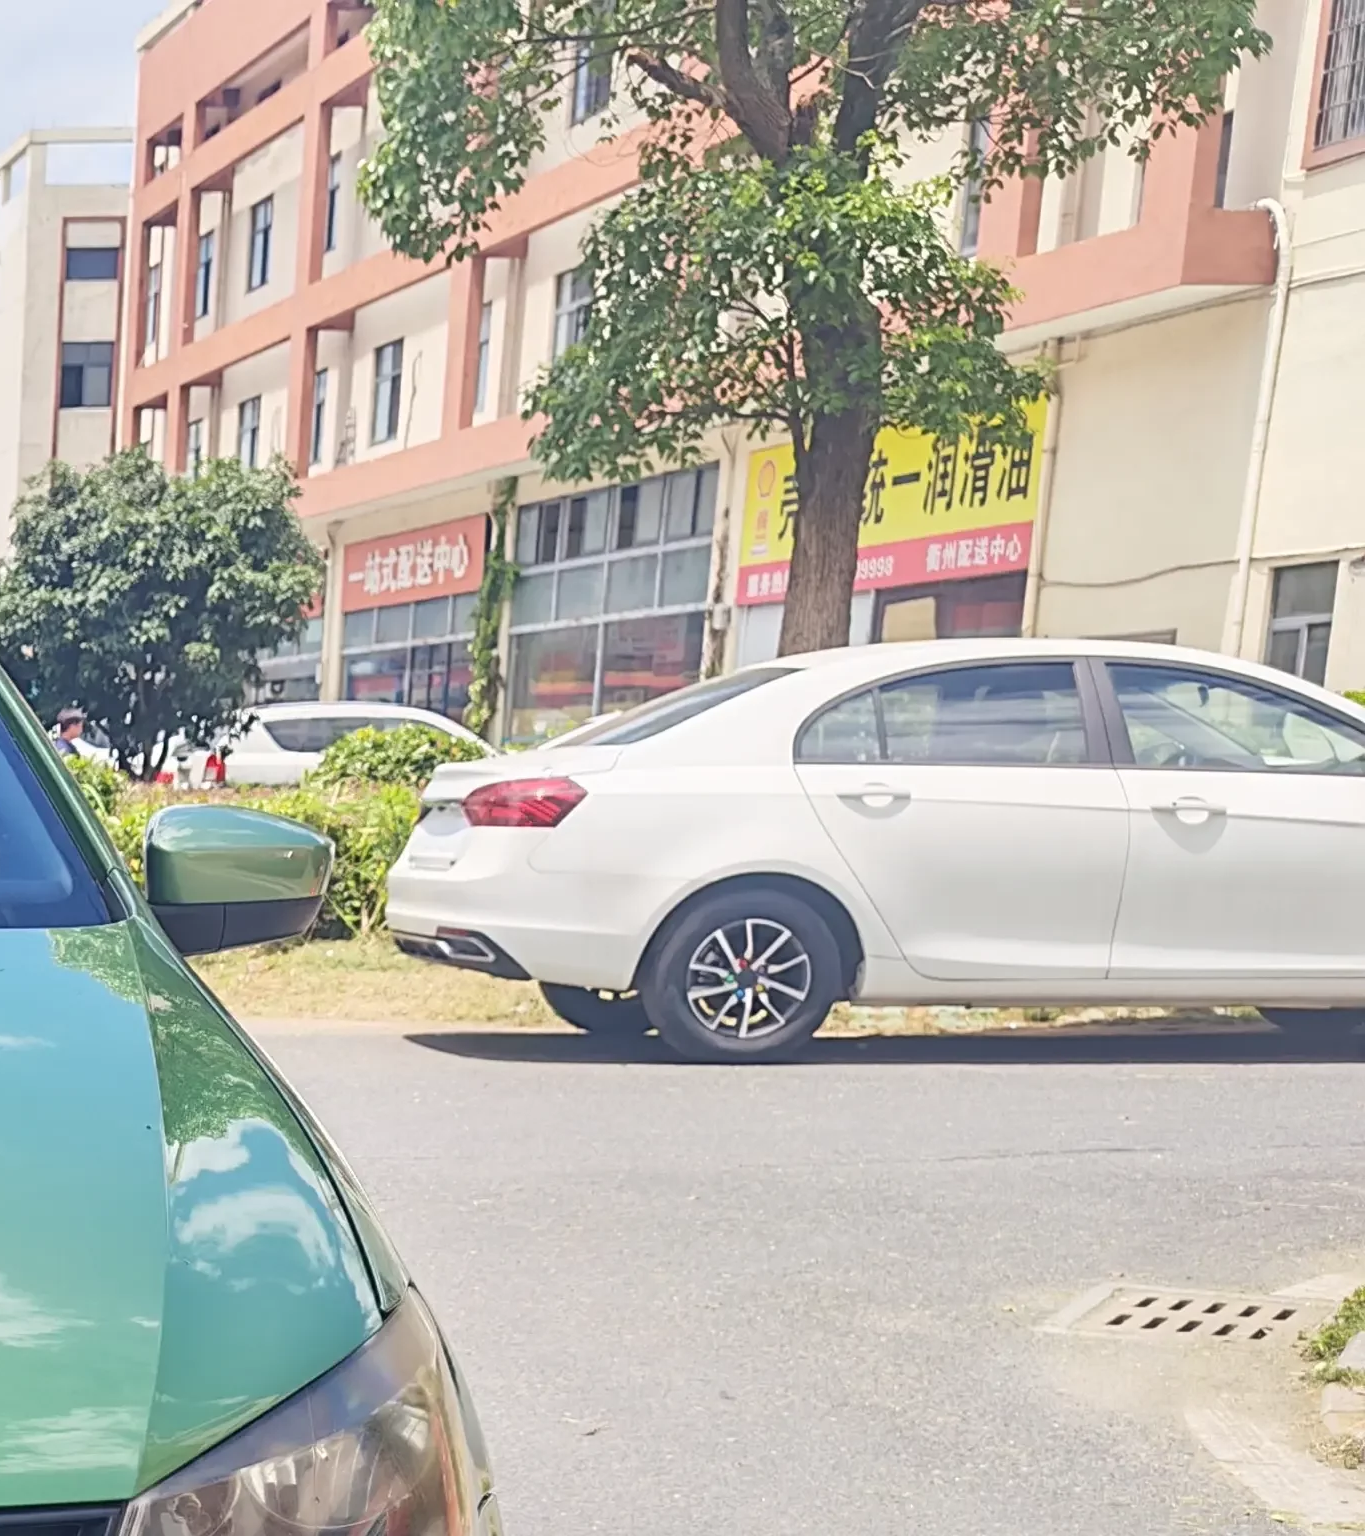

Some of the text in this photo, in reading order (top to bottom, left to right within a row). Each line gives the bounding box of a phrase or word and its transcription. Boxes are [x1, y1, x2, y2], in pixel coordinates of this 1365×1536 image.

[348, 533, 468, 596] 一站式配送中心
